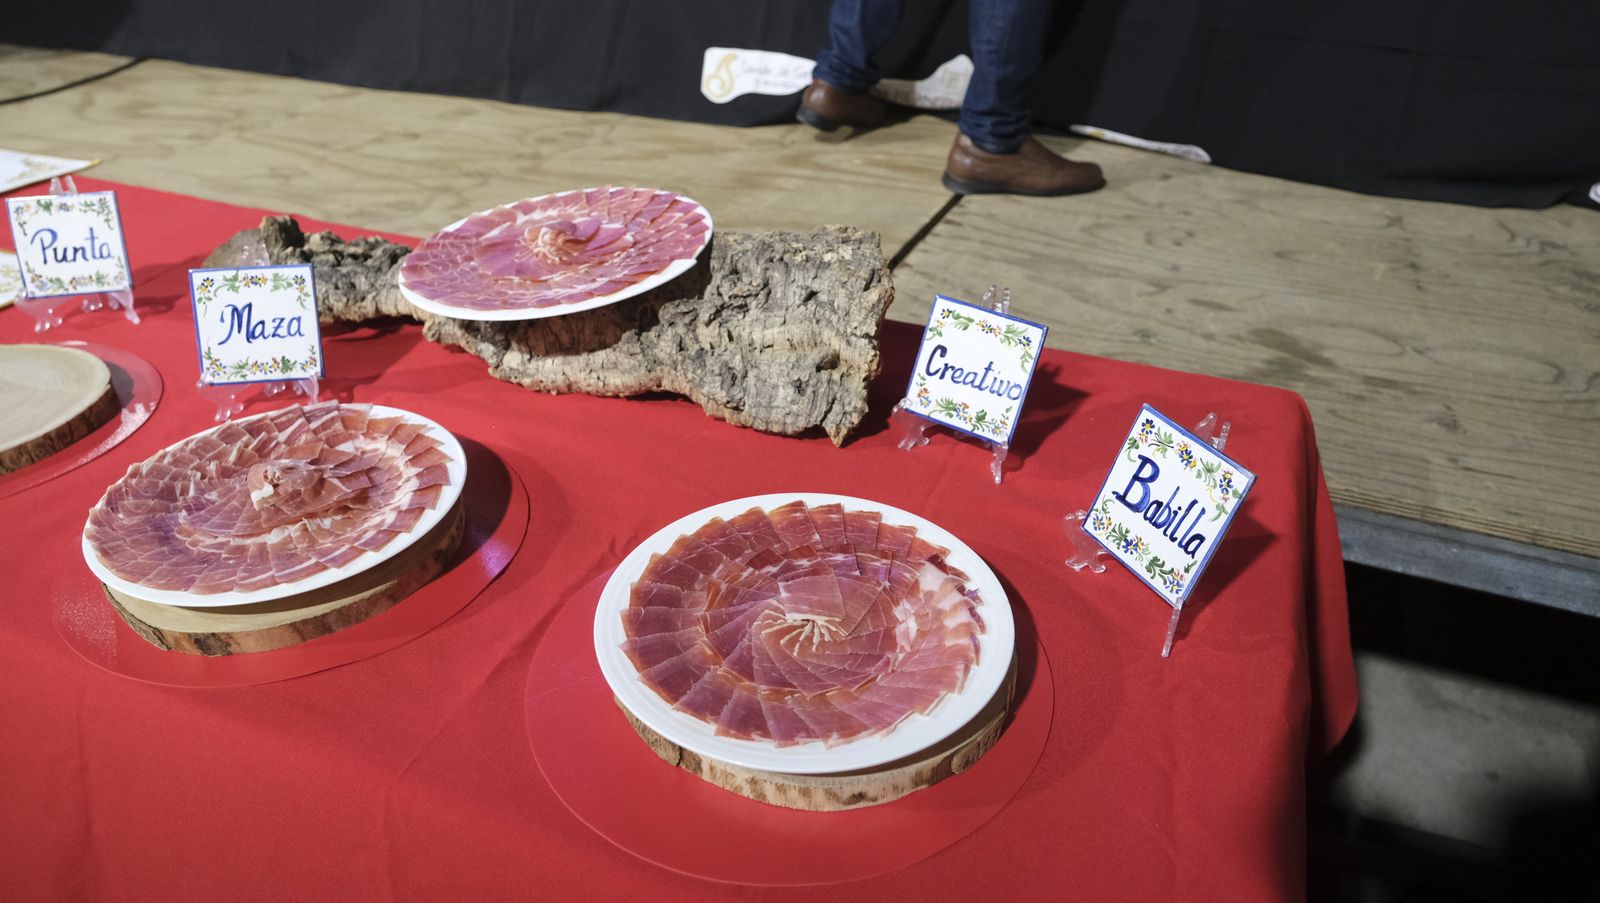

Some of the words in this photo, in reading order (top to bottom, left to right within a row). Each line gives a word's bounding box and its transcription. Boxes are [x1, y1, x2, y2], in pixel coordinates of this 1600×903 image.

[31, 227, 113, 265] Punta
[217, 302, 305, 346] Maza
[925, 344, 1023, 401] Creativo
[1111, 454, 1206, 559] Babilla
